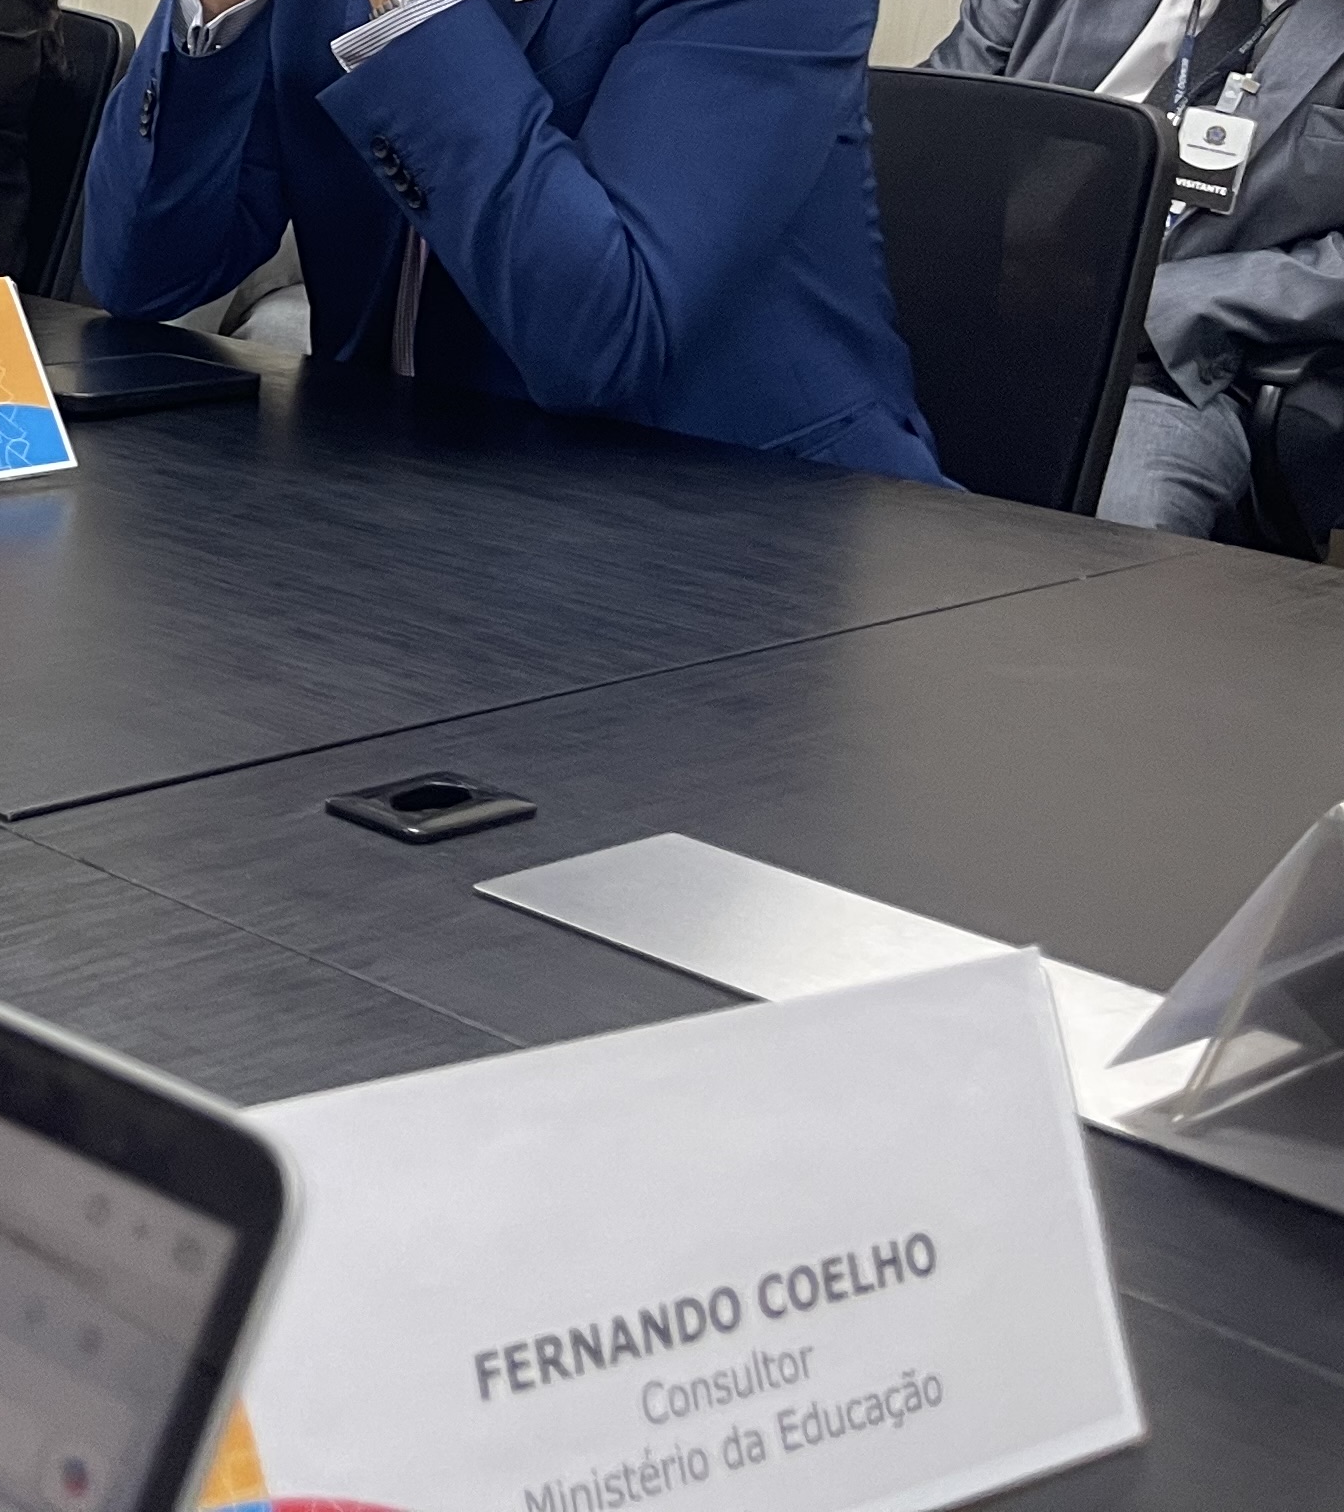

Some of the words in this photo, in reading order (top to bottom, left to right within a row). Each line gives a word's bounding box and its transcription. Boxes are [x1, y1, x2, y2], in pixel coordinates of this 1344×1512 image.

[475, 1286, 740, 1401] FERNANDO
[758, 1231, 938, 1320] COELHO
[641, 1343, 815, 1426] Consultor
[523, 1443, 709, 1512] Ministério
[722, 1420, 769, 1469] da
[779, 1367, 944, 1455] Educação
